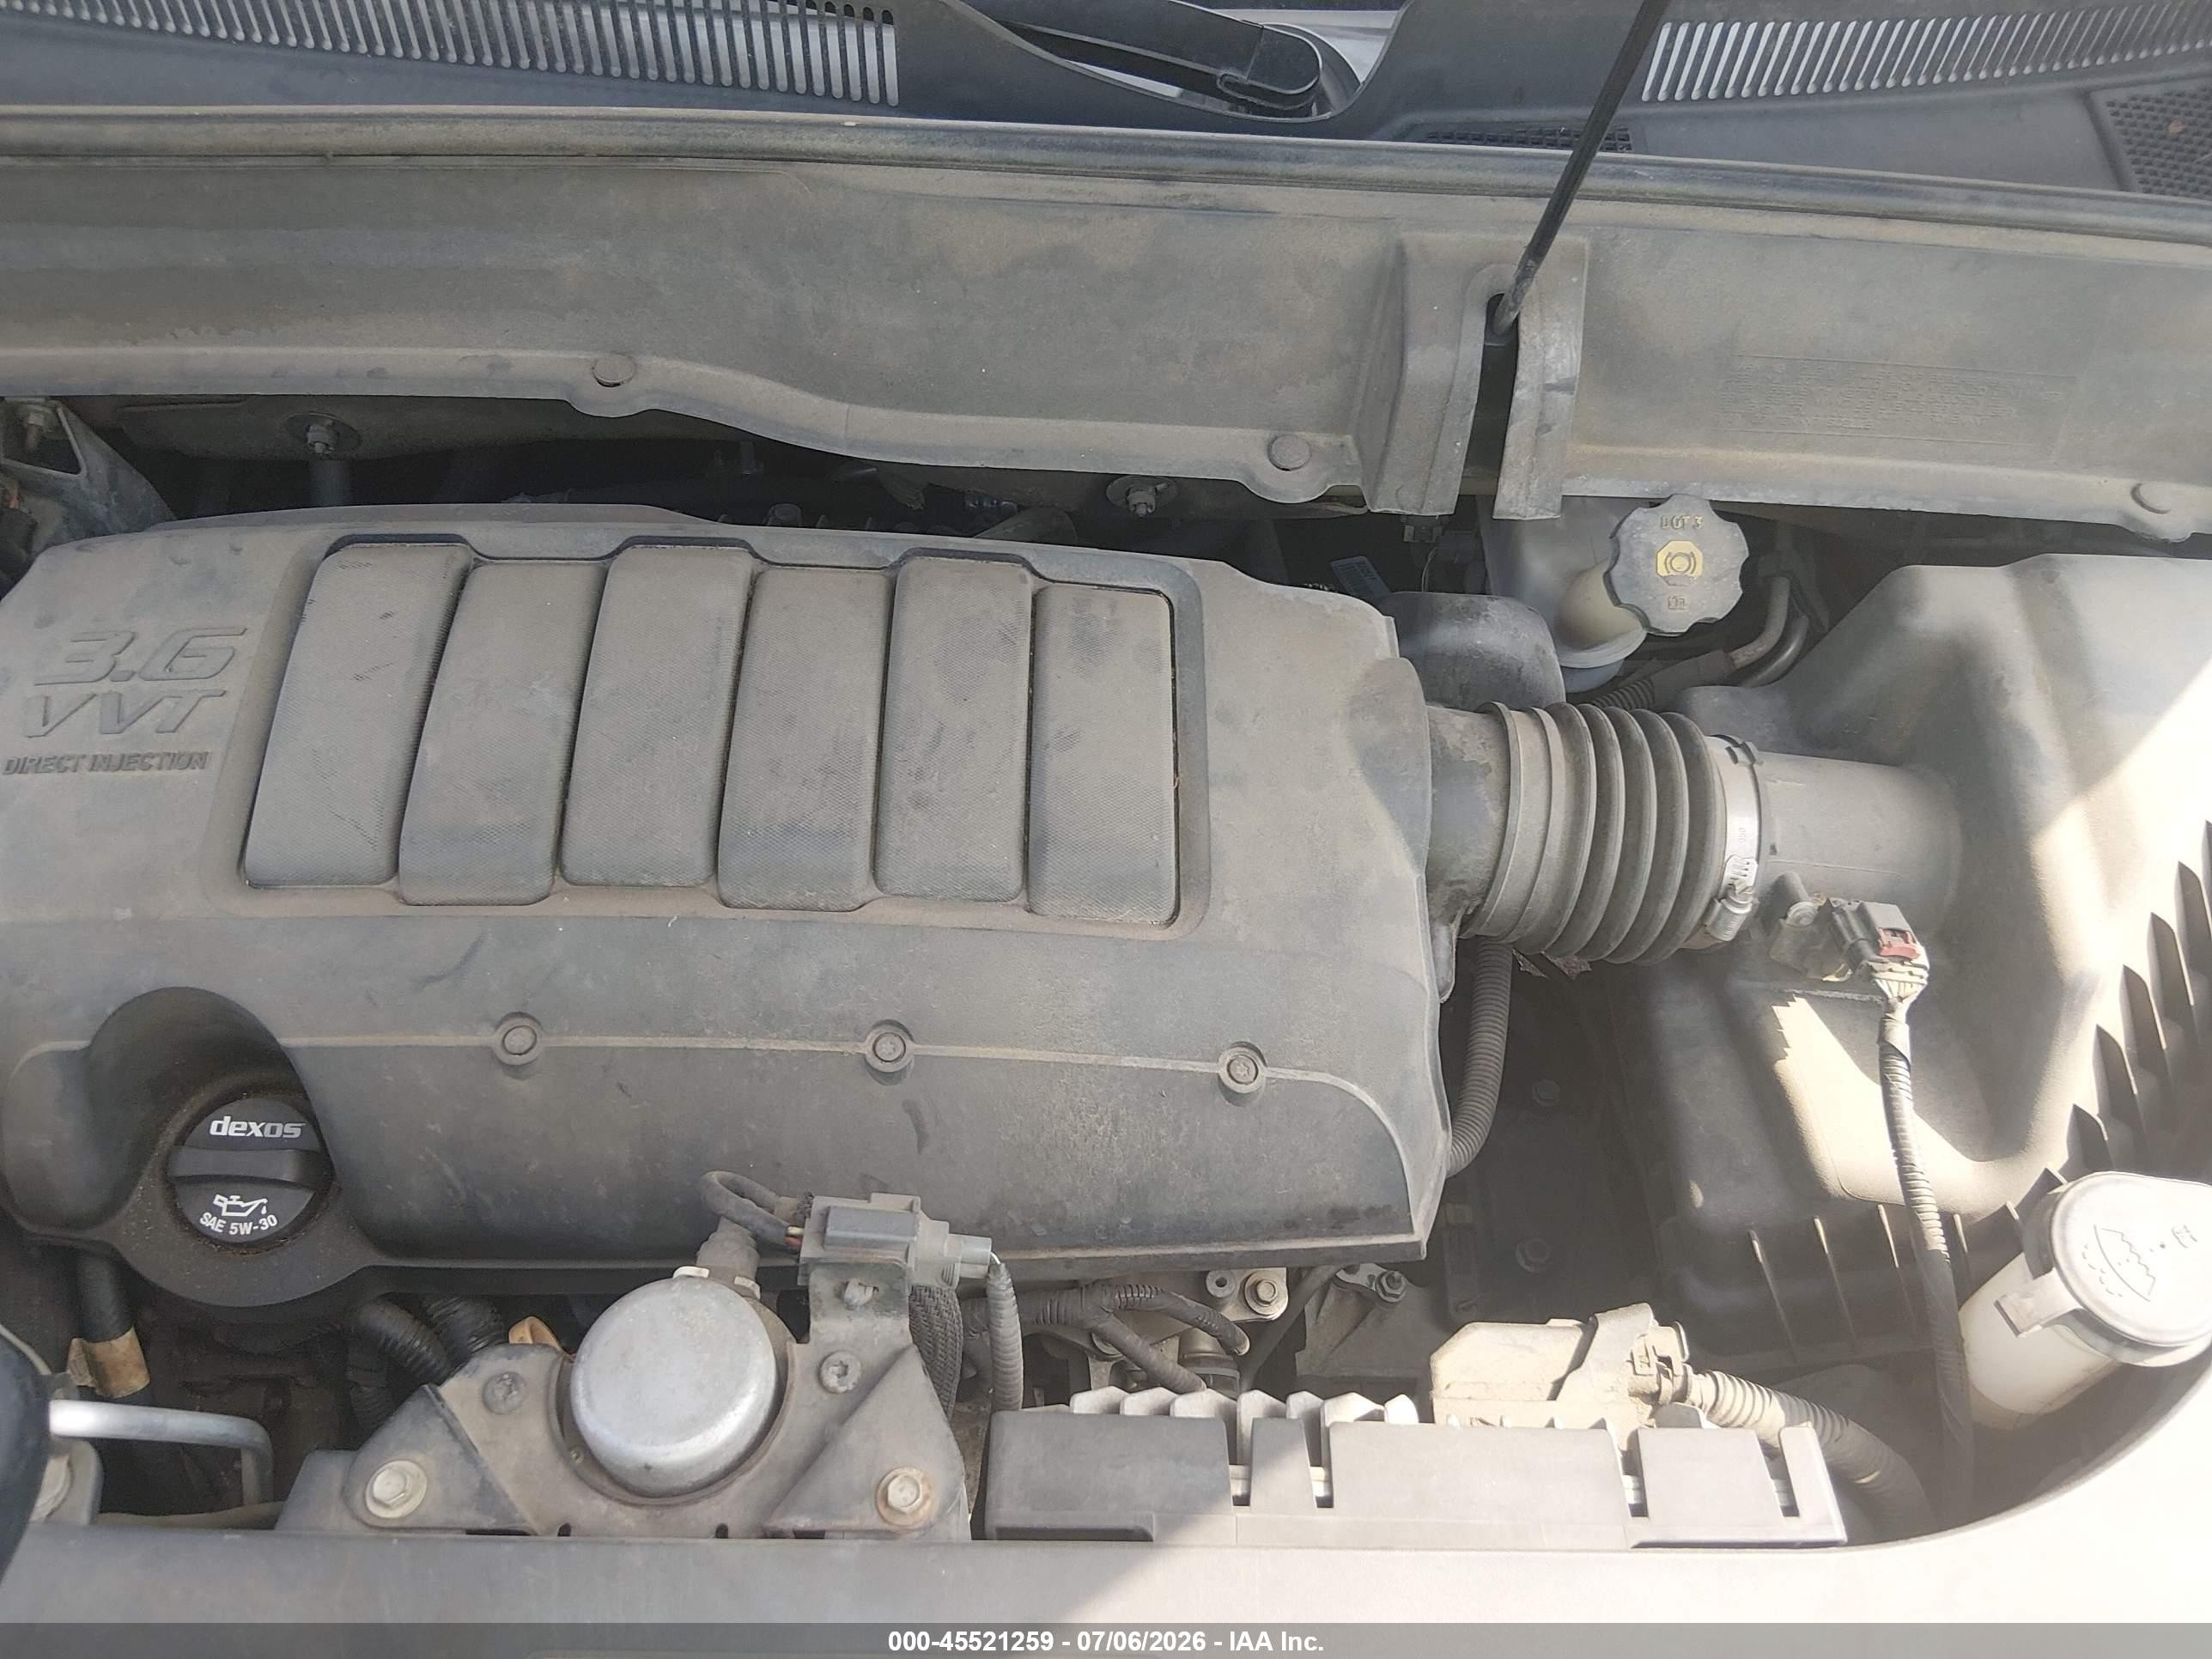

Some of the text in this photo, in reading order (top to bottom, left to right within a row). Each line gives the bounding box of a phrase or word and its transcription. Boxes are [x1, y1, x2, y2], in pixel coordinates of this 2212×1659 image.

[34, 627, 247, 686] 3.6
[23, 690, 227, 738] VVT
[4, 751, 212, 775] DIRECT INJECTION
[210, 1116, 306, 1139] dexos
[200, 1212, 277, 1236] SAE 5W-30
